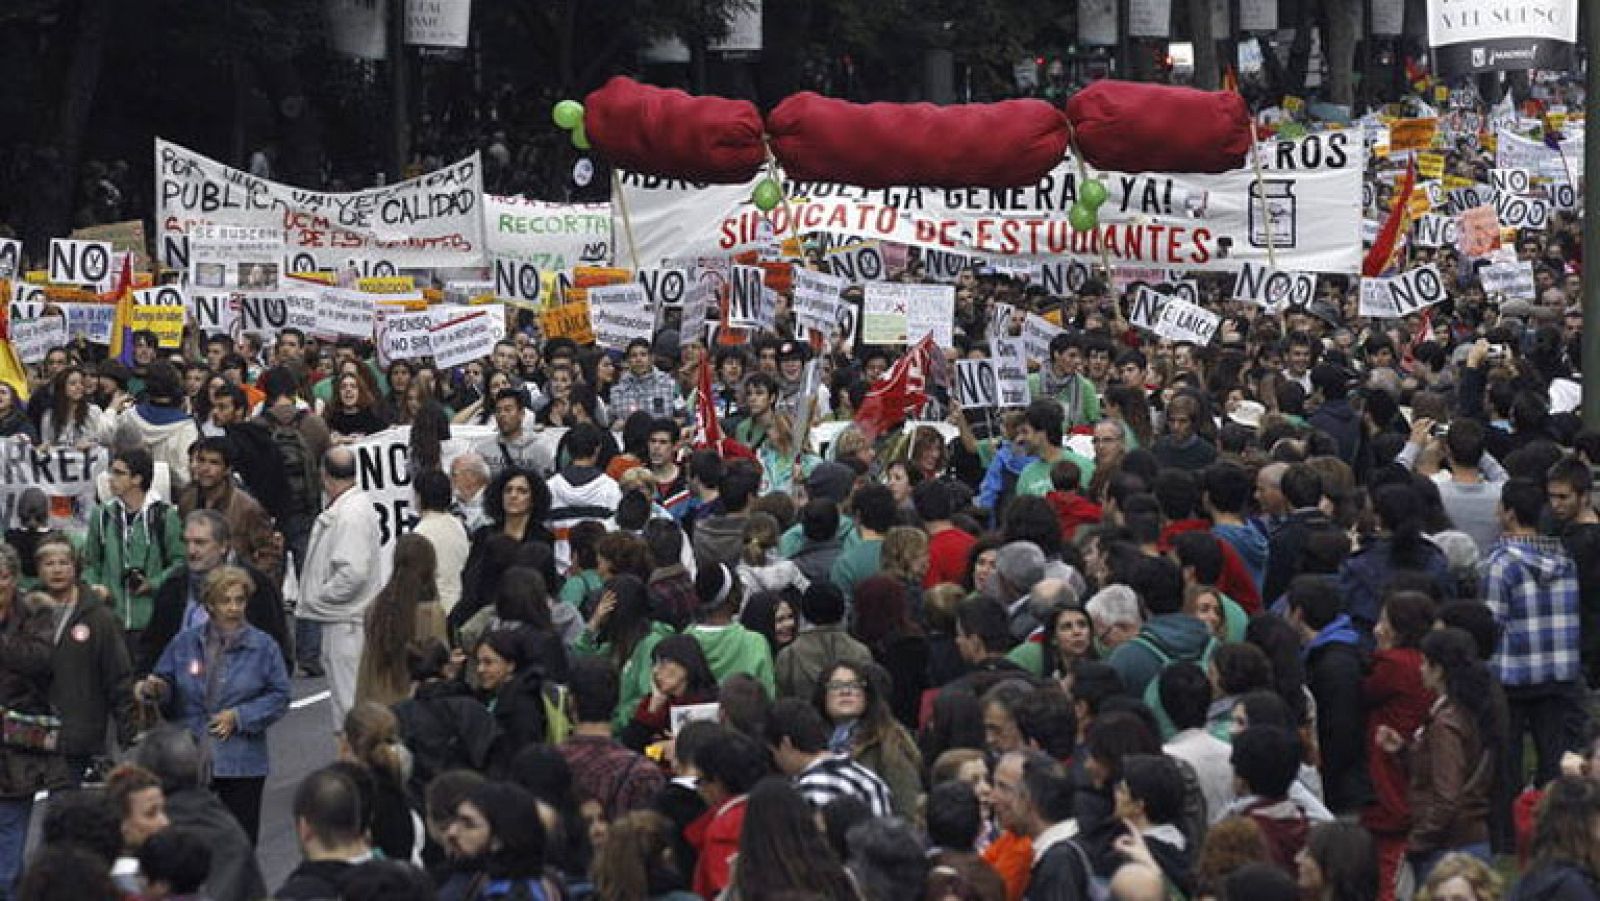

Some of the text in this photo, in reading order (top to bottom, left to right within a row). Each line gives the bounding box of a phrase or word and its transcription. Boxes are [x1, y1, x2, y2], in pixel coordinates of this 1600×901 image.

[1262, 133, 1347, 170] ROS
[944, 173, 1079, 210] GENERA
[1120, 176, 1173, 214] YA!
[1490, 171, 1528, 191] NO
[381, 189, 475, 225] CALIDAD
[915, 217, 958, 248] DE
[52, 241, 110, 282] NO
[495, 259, 540, 300] NO
[831, 247, 880, 283] NO
[1041, 258, 1088, 297] NO
[639, 269, 685, 303] NO
[1237, 262, 1292, 305] NO
[1388, 267, 1442, 310] NO
[240, 296, 287, 329] NO
